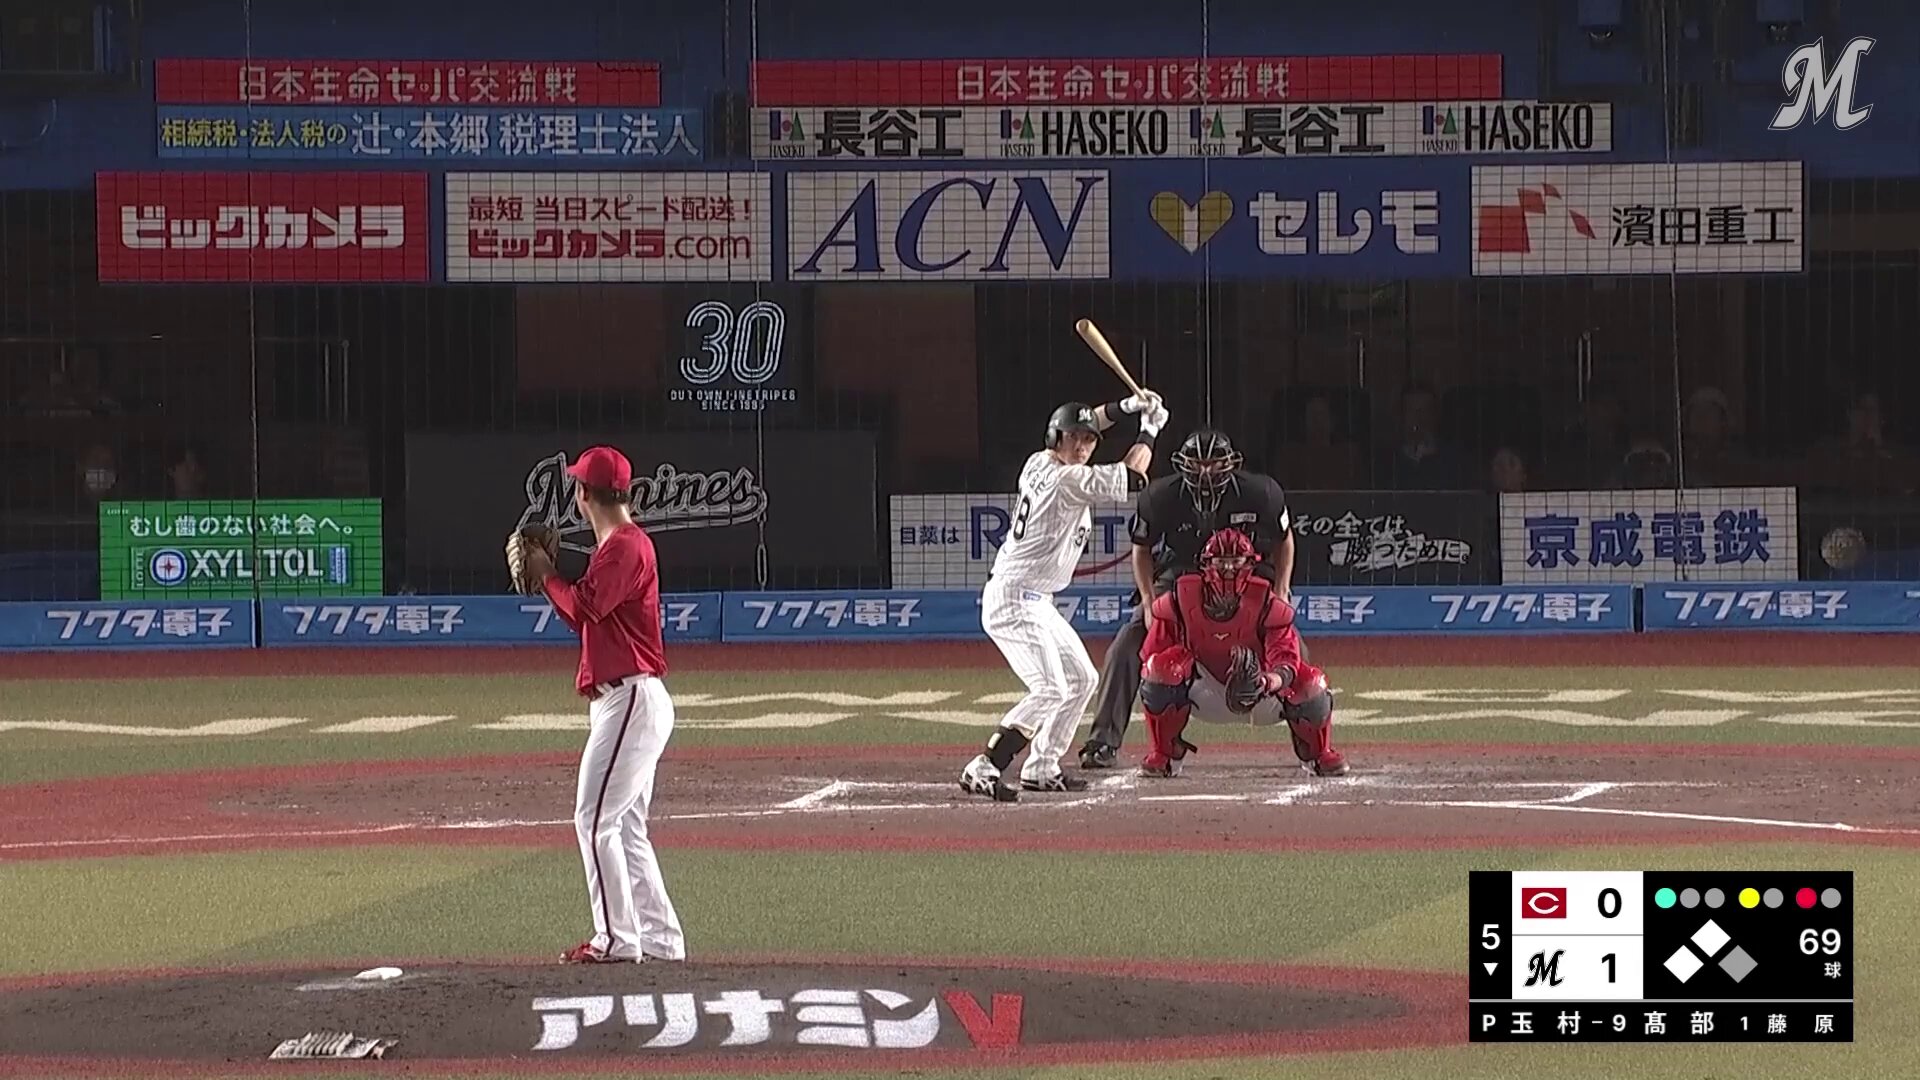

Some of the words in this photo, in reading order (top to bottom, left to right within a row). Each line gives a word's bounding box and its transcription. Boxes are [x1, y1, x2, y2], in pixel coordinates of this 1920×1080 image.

[815, 109, 964, 157] 長谷工
[1042, 109, 1168, 156] HASEKO
[1235, 106, 1385, 156] 長谷工
[1465, 103, 1593, 151] HASEKO
[120, 204, 405, 251] ビックカメラ
[468, 195, 524, 222] 最短
[793, 177, 1105, 273] ACN
[1249, 190, 1440, 255] セレモ
[1612, 204, 1795, 247] 濱田重工
[468, 228, 751, 260] ビックカメラ.com
[680, 301, 785, 384] 30
[696, 389, 722, 401] OWN
[701, 400, 736, 411] SINCE
[130, 513, 353, 537] むし歯のない社会へ。
[900, 525, 961, 546] 目薬は
[1524, 508, 1771, 570] 京成電鉄
